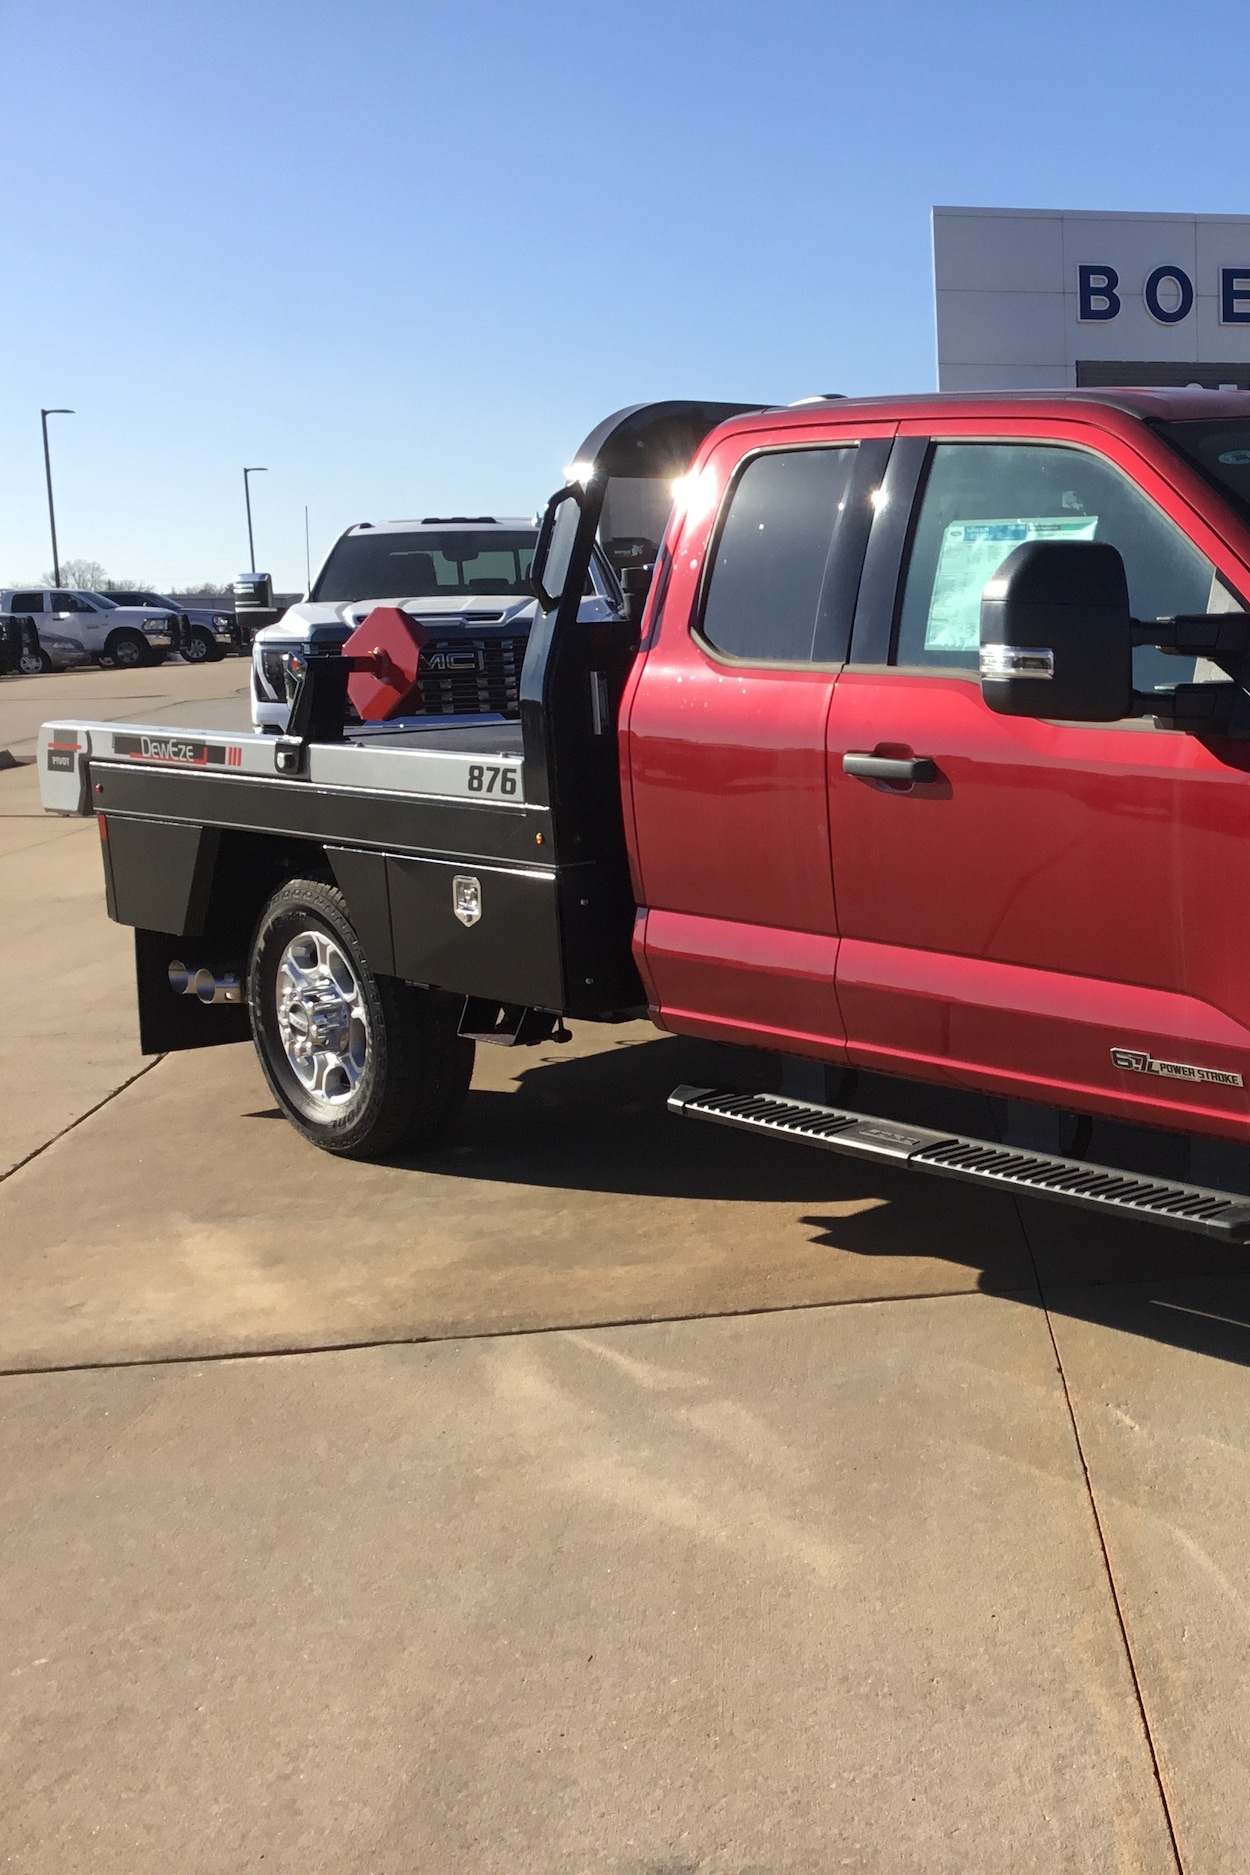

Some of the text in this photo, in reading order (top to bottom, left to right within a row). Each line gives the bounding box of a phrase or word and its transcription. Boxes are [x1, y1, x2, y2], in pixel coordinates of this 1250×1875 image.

[420, 653, 476, 670] MC
[467, 765, 518, 795] 876
[1159, 1062, 1195, 1077] POWER
[1197, 1069, 1239, 1085] STROKE
